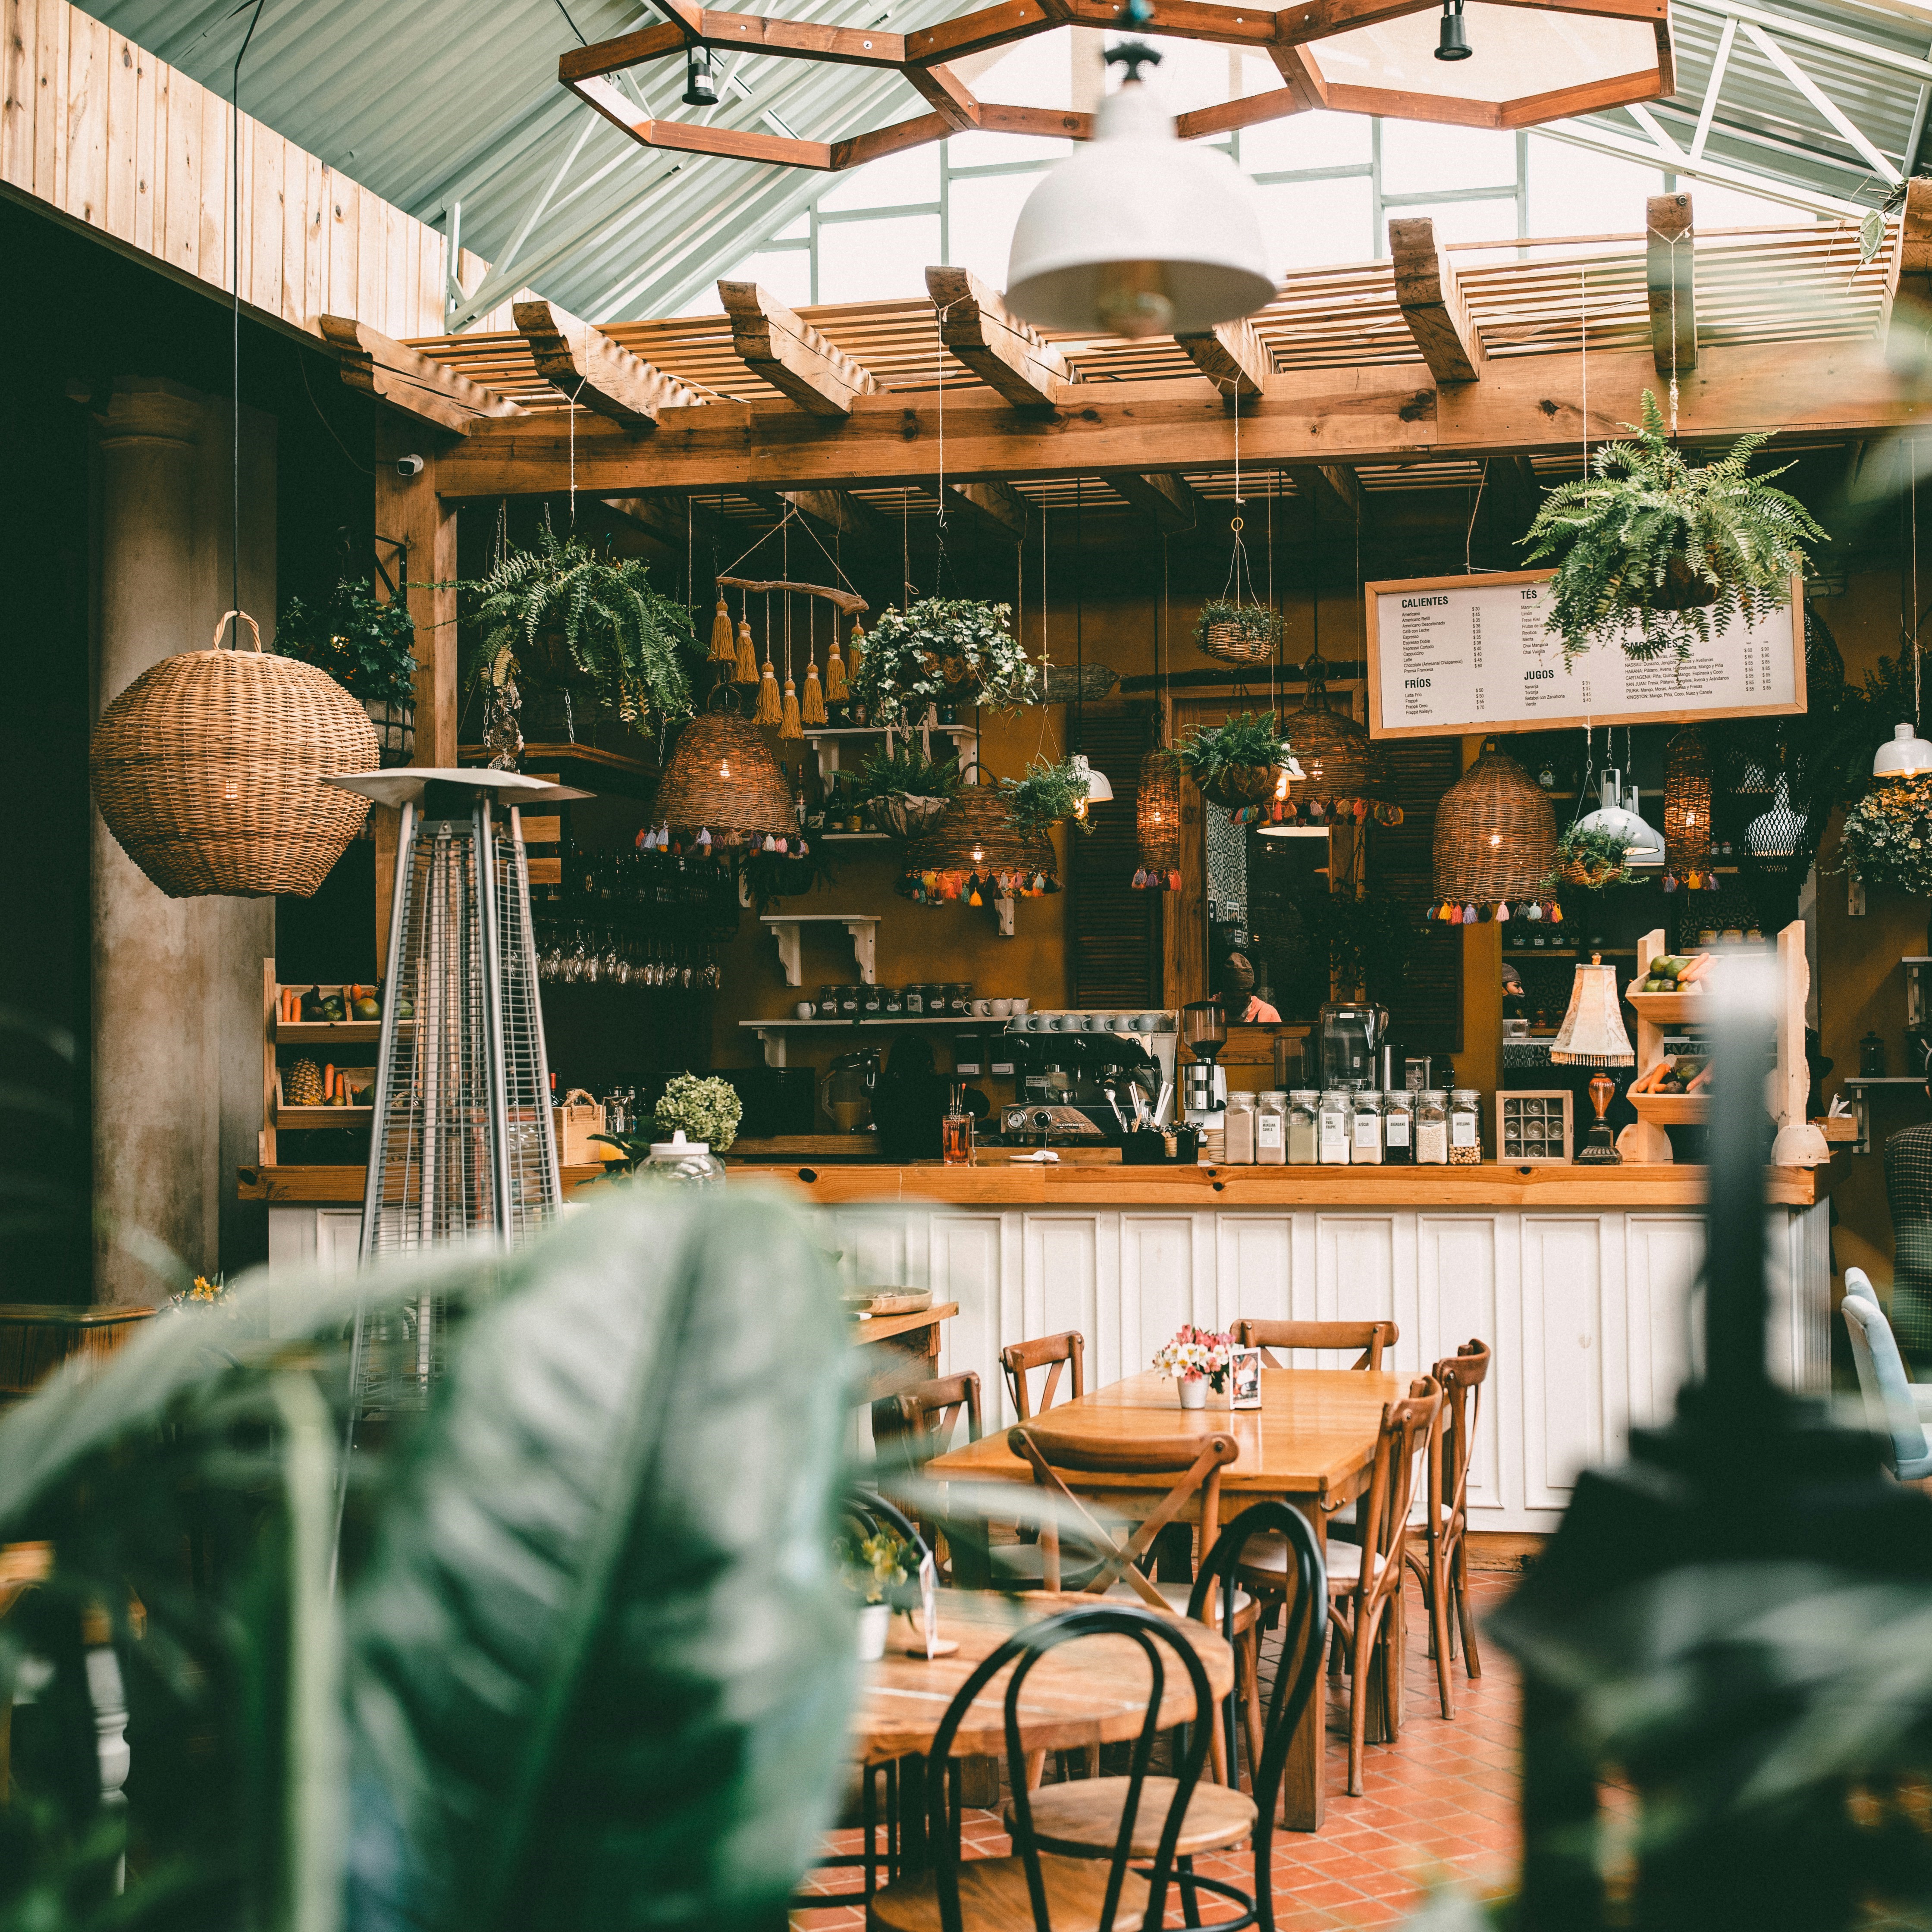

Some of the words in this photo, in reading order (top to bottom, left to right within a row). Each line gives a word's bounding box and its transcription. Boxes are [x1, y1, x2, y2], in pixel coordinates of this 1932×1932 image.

[1521, 589, 1537, 599] TÉS
[1402, 596, 1448, 608] CALIENTES
[1524, 670, 1554, 680] JUGOS
[1405, 677, 1431, 688] FRÍOS
